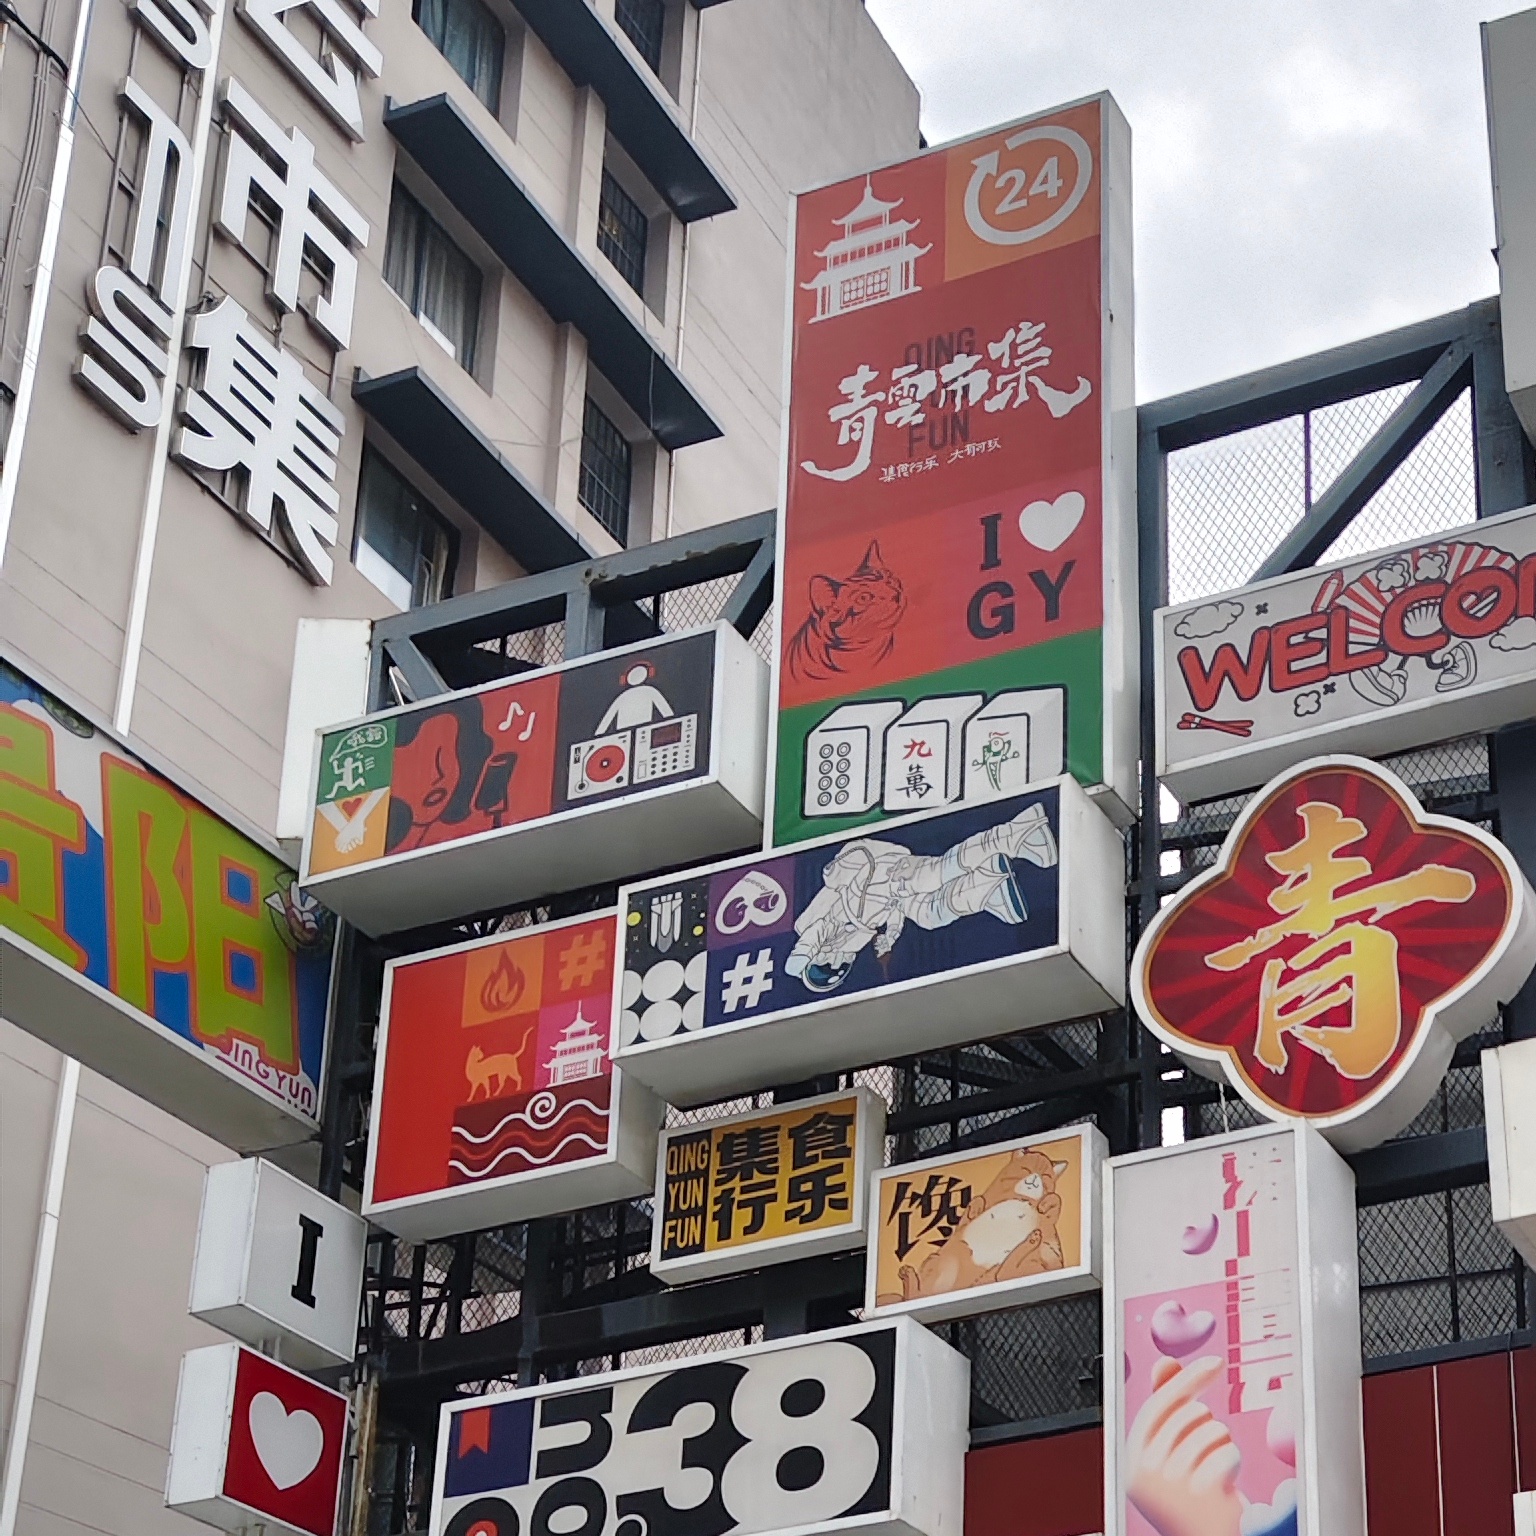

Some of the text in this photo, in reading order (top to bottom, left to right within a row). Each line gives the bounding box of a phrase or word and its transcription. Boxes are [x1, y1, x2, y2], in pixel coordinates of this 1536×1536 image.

[994, 155, 1063, 216] 24
[979, 512, 1002, 572] I
[966, 559, 1077, 641] GY
[1204, 801, 1476, 1080] 青
[667, 1138, 708, 1177] QING
[664, 1177, 704, 1214] YUN
[290, 1212, 324, 1311] I
[663, 1214, 703, 1253] FUN
